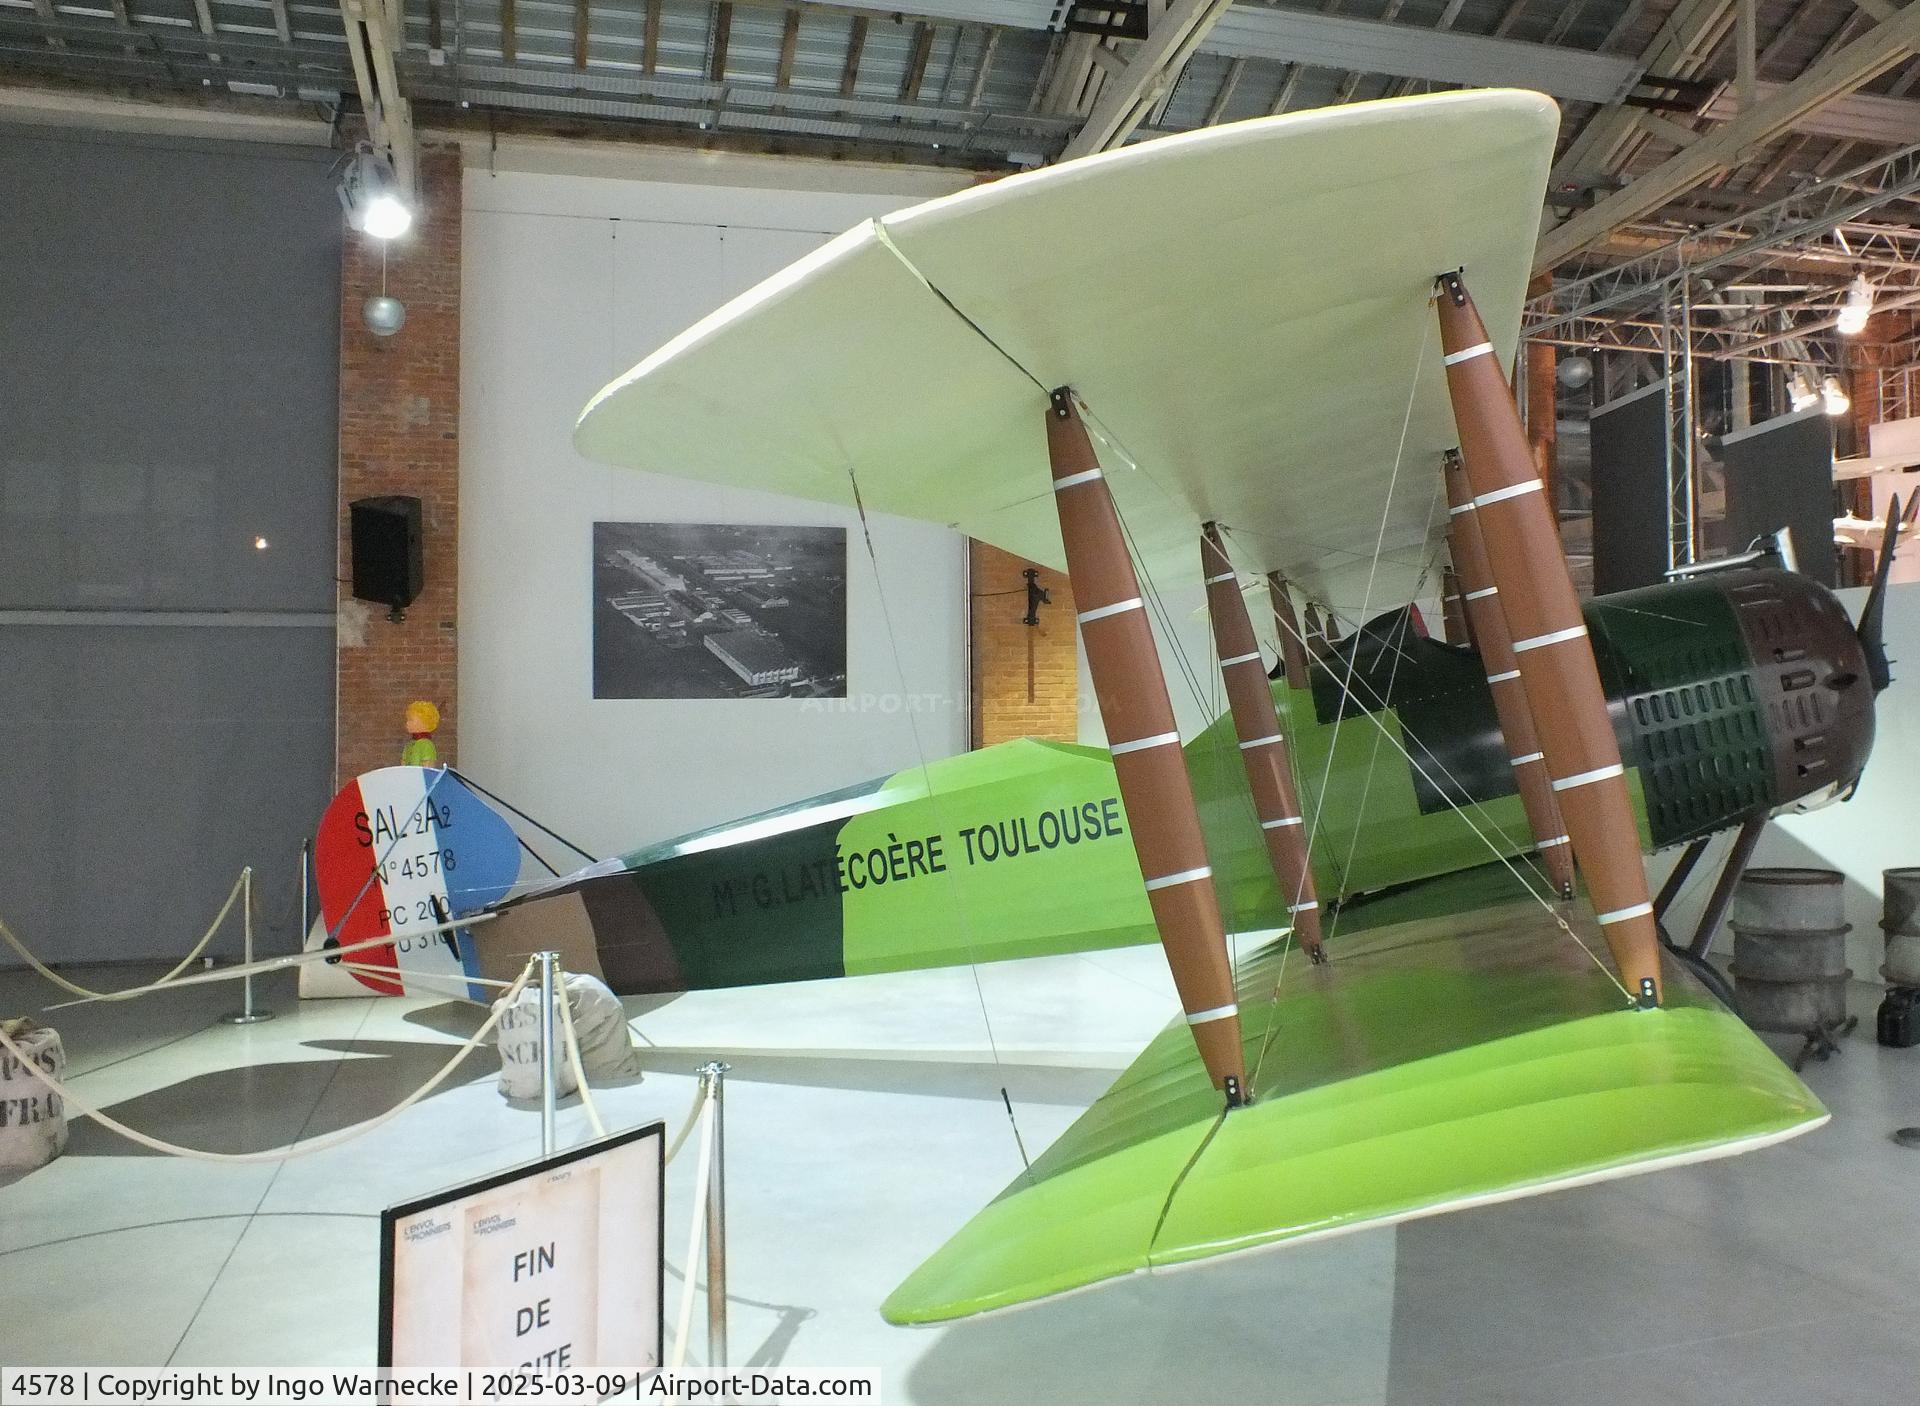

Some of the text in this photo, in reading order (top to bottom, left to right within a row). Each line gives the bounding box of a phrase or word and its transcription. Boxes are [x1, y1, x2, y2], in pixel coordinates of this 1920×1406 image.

[354, 805, 408, 848] SAL
[959, 797, 1124, 866] TOULOUSE
[378, 905, 409, 929] PC
[513, 1242, 556, 1283] FIN
[516, 1298, 551, 1338] DE
